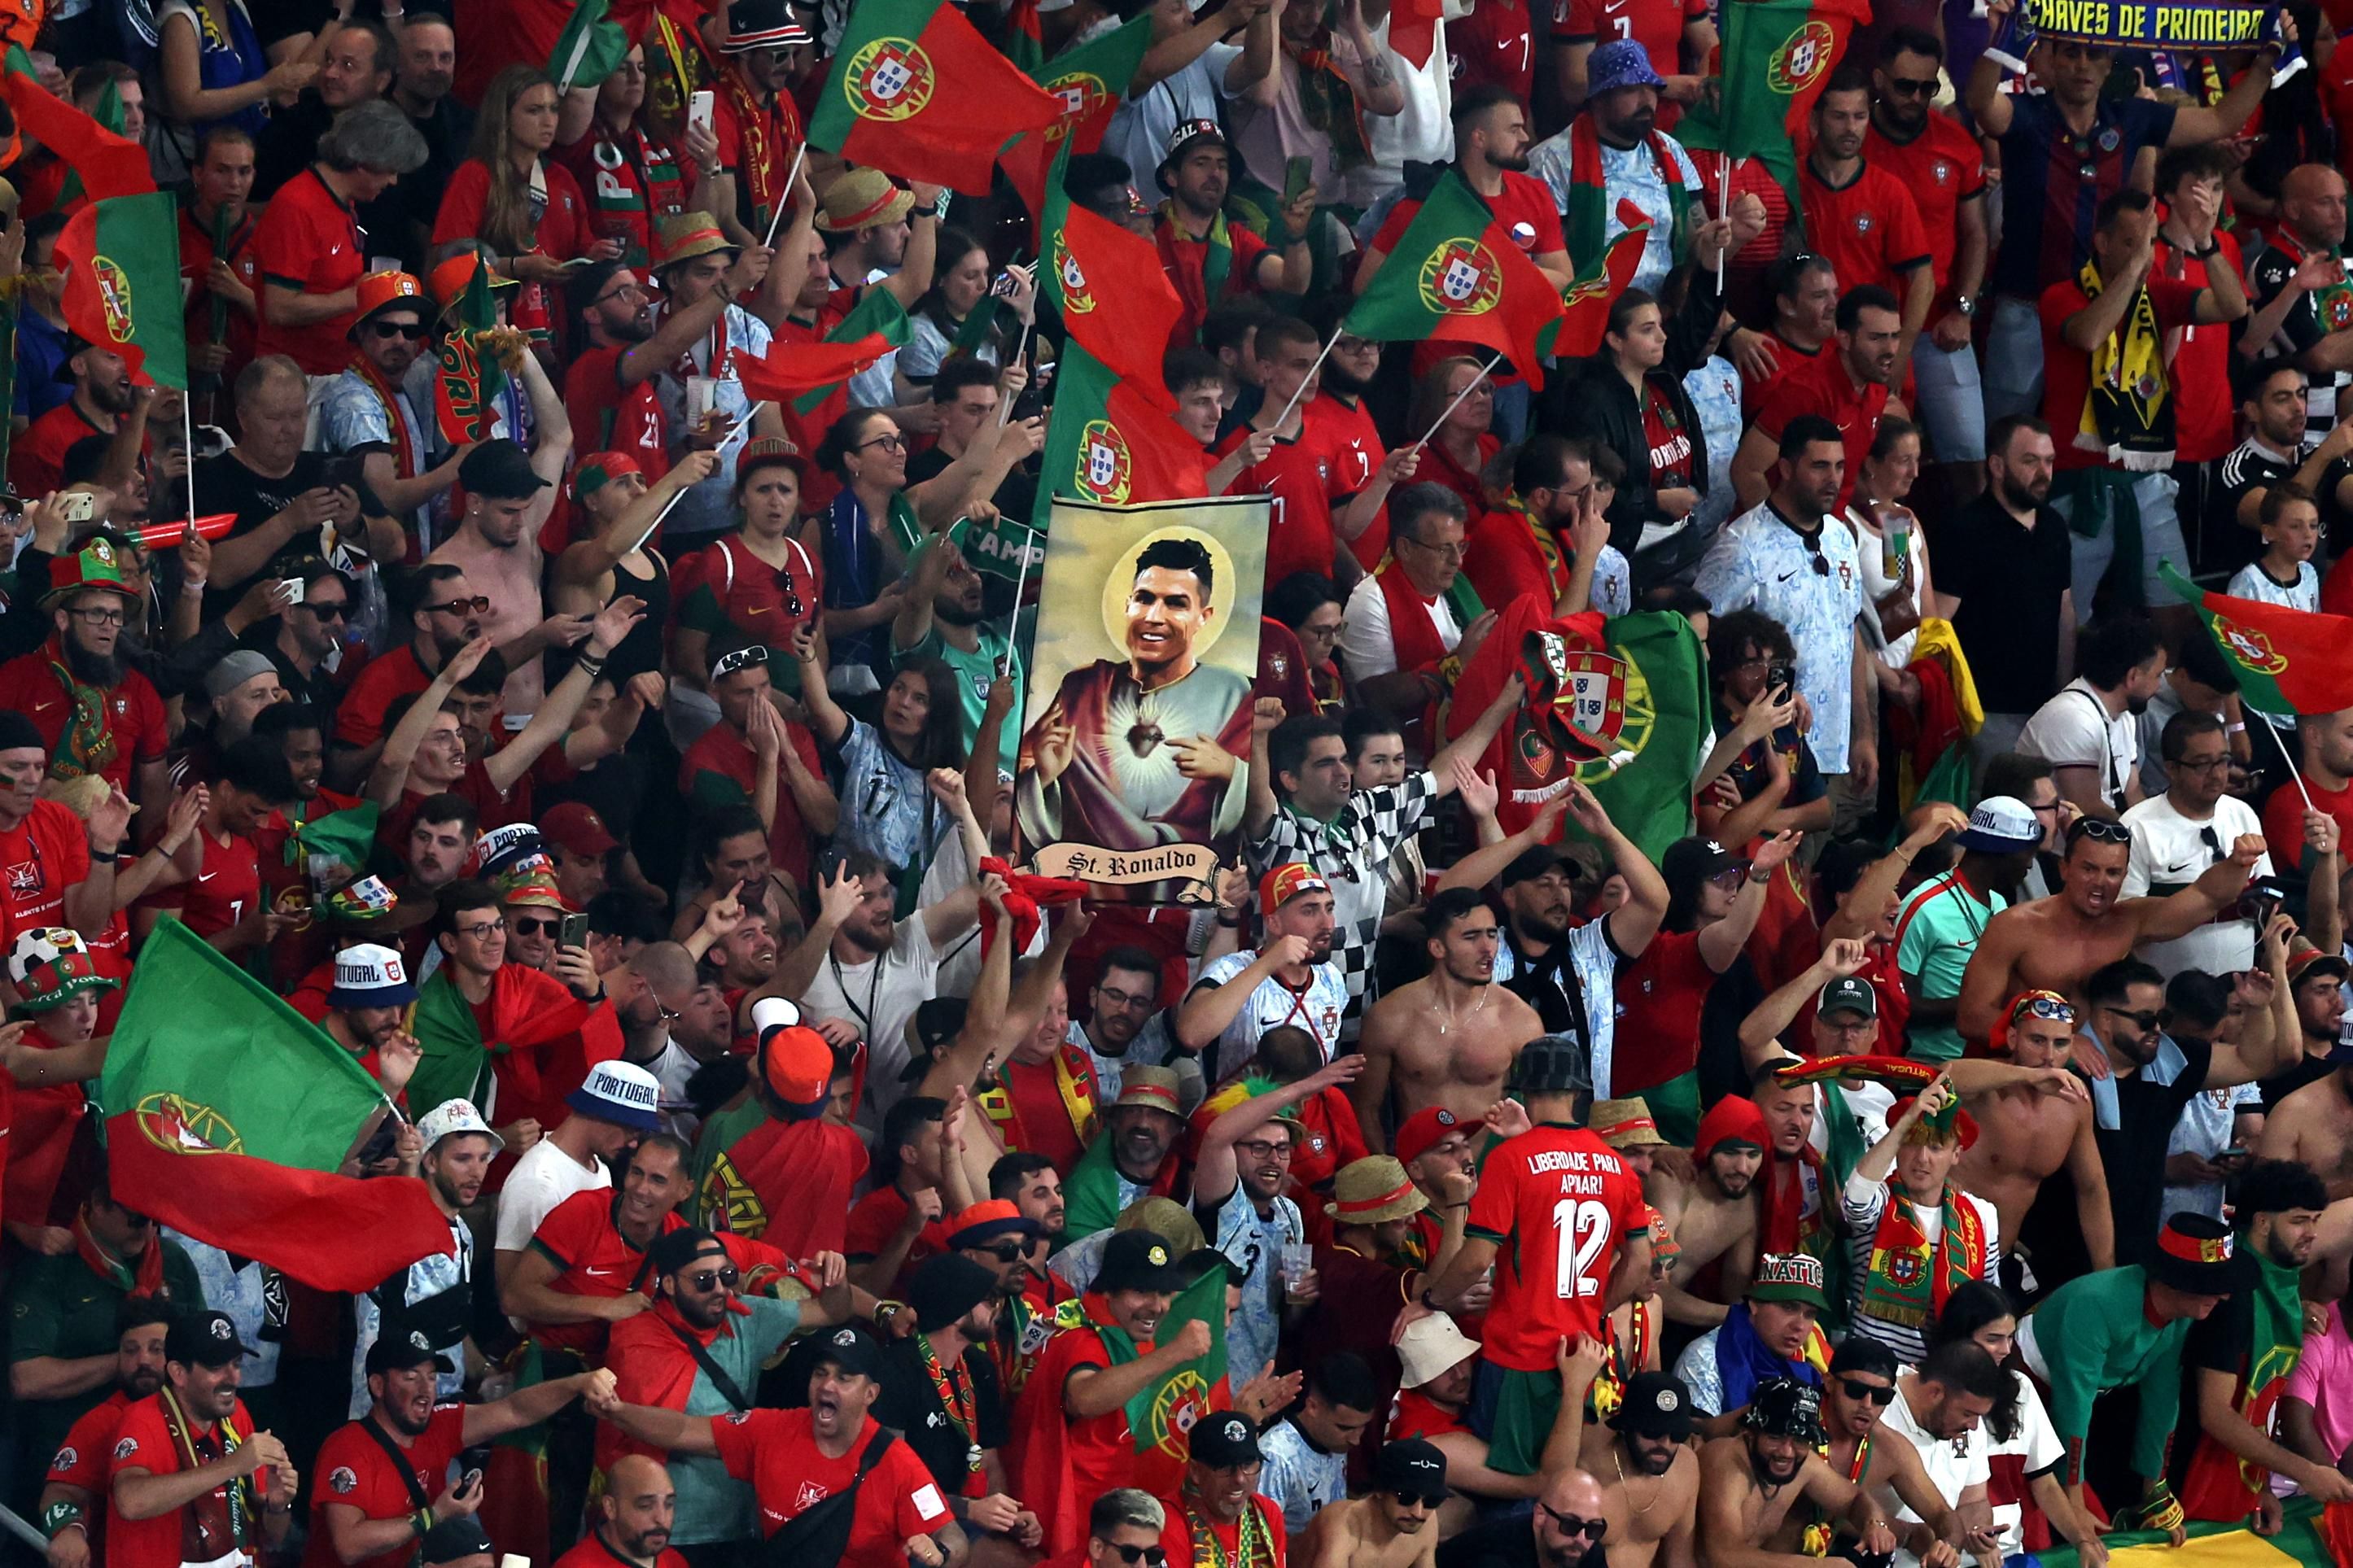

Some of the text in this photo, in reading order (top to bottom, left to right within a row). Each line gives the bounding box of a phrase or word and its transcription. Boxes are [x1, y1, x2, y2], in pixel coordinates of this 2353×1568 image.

[2027, 0, 2265, 41] CHAVES DE PRIMEIRA
[1520, 32, 1531, 72] 7
[1066, 850, 1196, 878] St. Ronaldo
[230, 900, 243, 926] 7
[594, 1072, 656, 1106] PORTUGAL
[1527, 1151, 1622, 1175] LIBERDADE PARA
[1553, 1199, 1610, 1299] 12
[1758, 1259, 1823, 1290] NATIC
